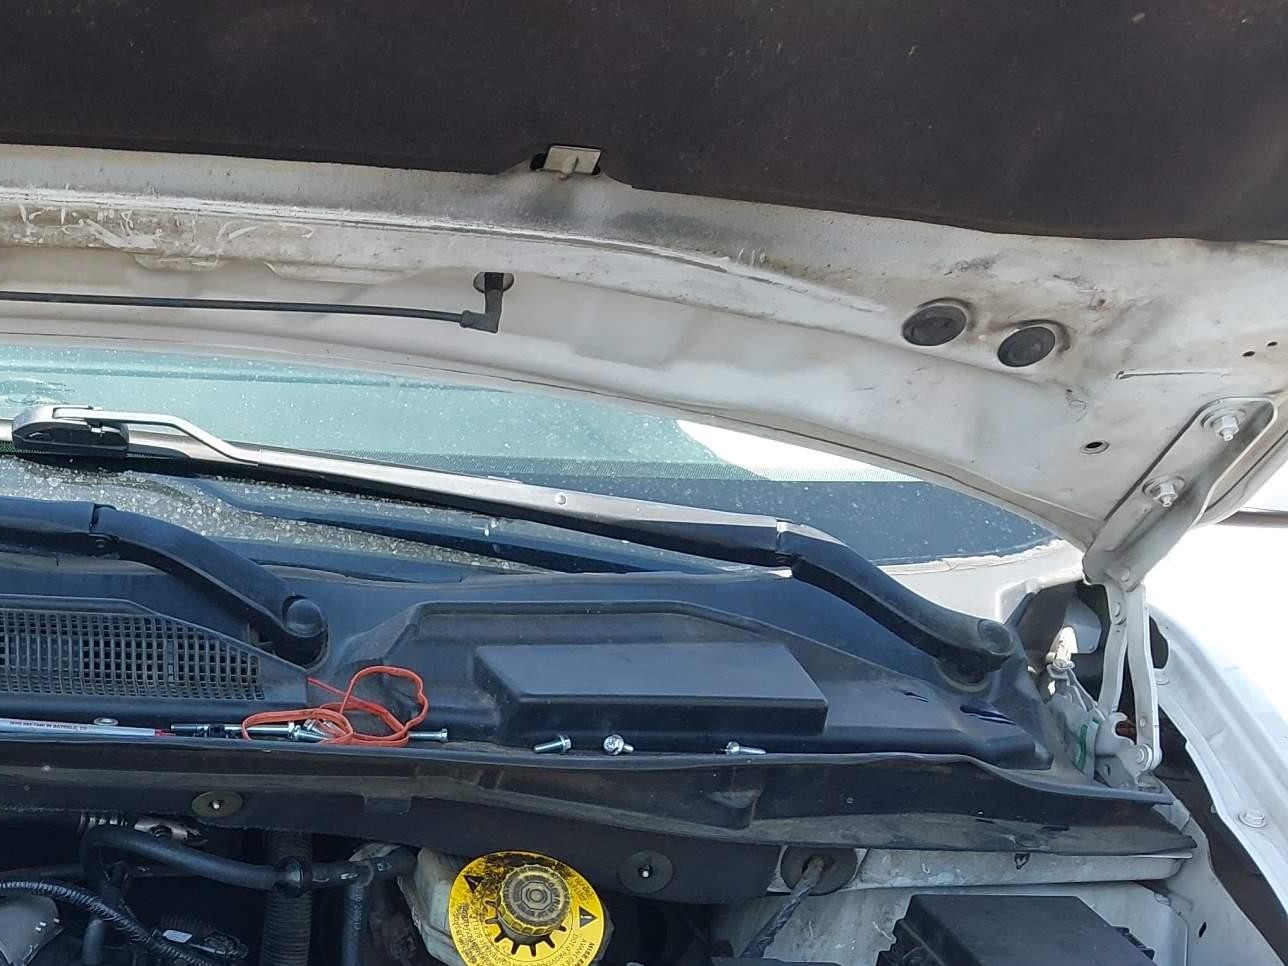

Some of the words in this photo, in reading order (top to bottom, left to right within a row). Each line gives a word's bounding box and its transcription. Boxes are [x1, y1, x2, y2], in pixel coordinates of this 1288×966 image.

[568, 933, 578, 947] DOT
[571, 937, 587, 958] AVANT
[580, 940, 595, 960] MISE
[564, 956, 575, 966] DE
